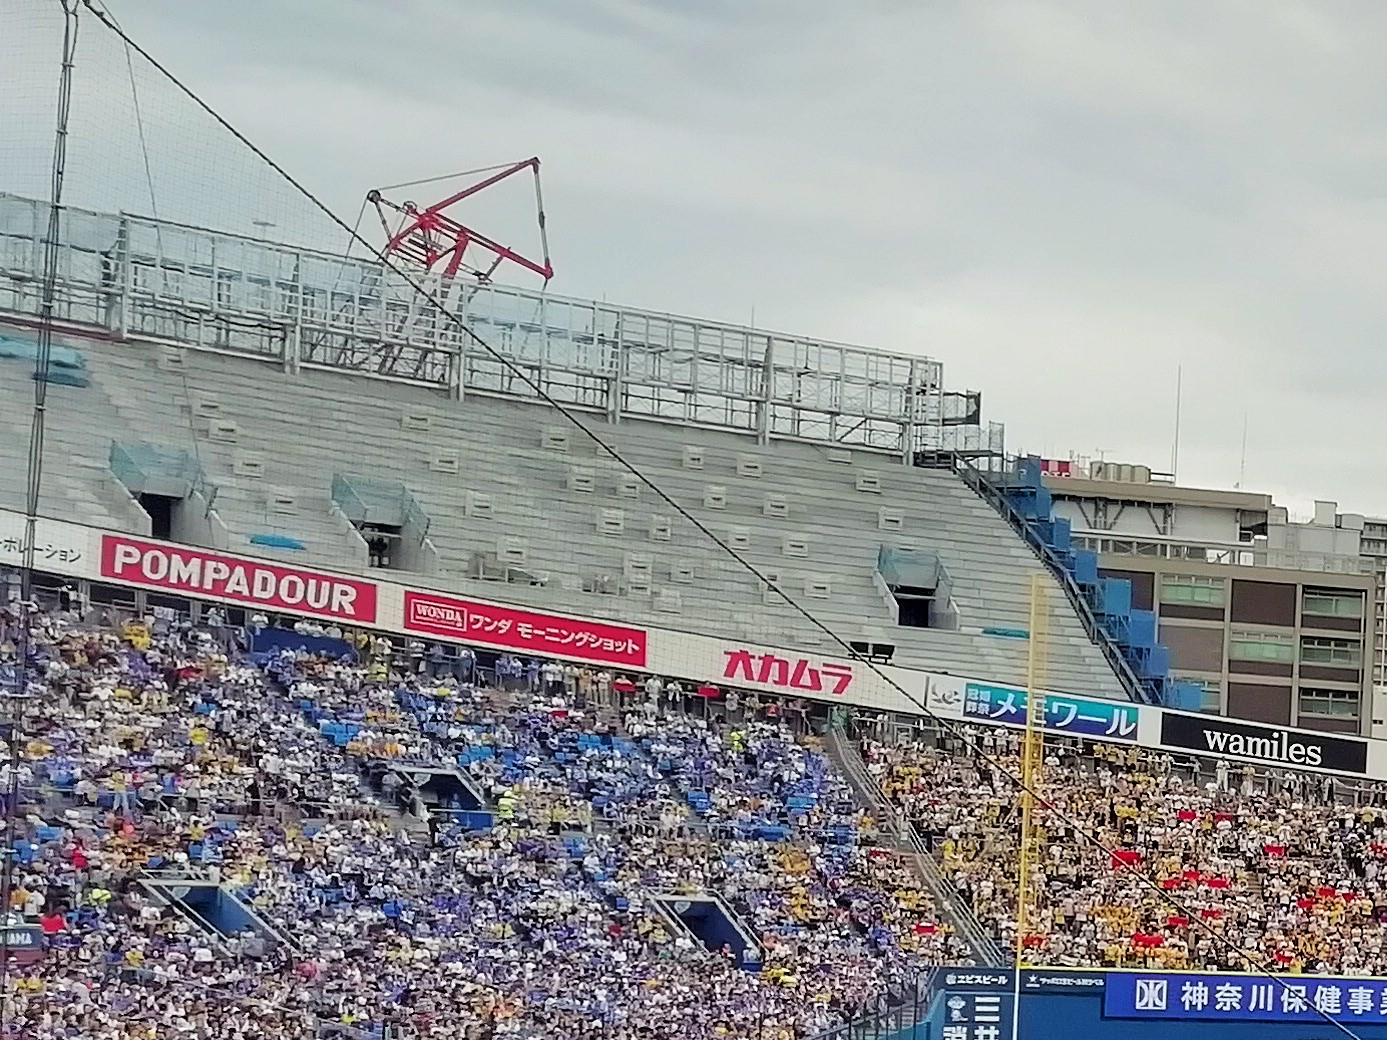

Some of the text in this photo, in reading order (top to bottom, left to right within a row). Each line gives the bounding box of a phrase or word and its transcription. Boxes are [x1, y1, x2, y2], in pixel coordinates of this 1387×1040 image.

[113, 543, 358, 617] POMPADOUR
[415, 603, 463, 622] WONDA
[470, 615, 640, 655] ワンダ モーニングショット
[1203, 730, 1322, 766] wamiles
